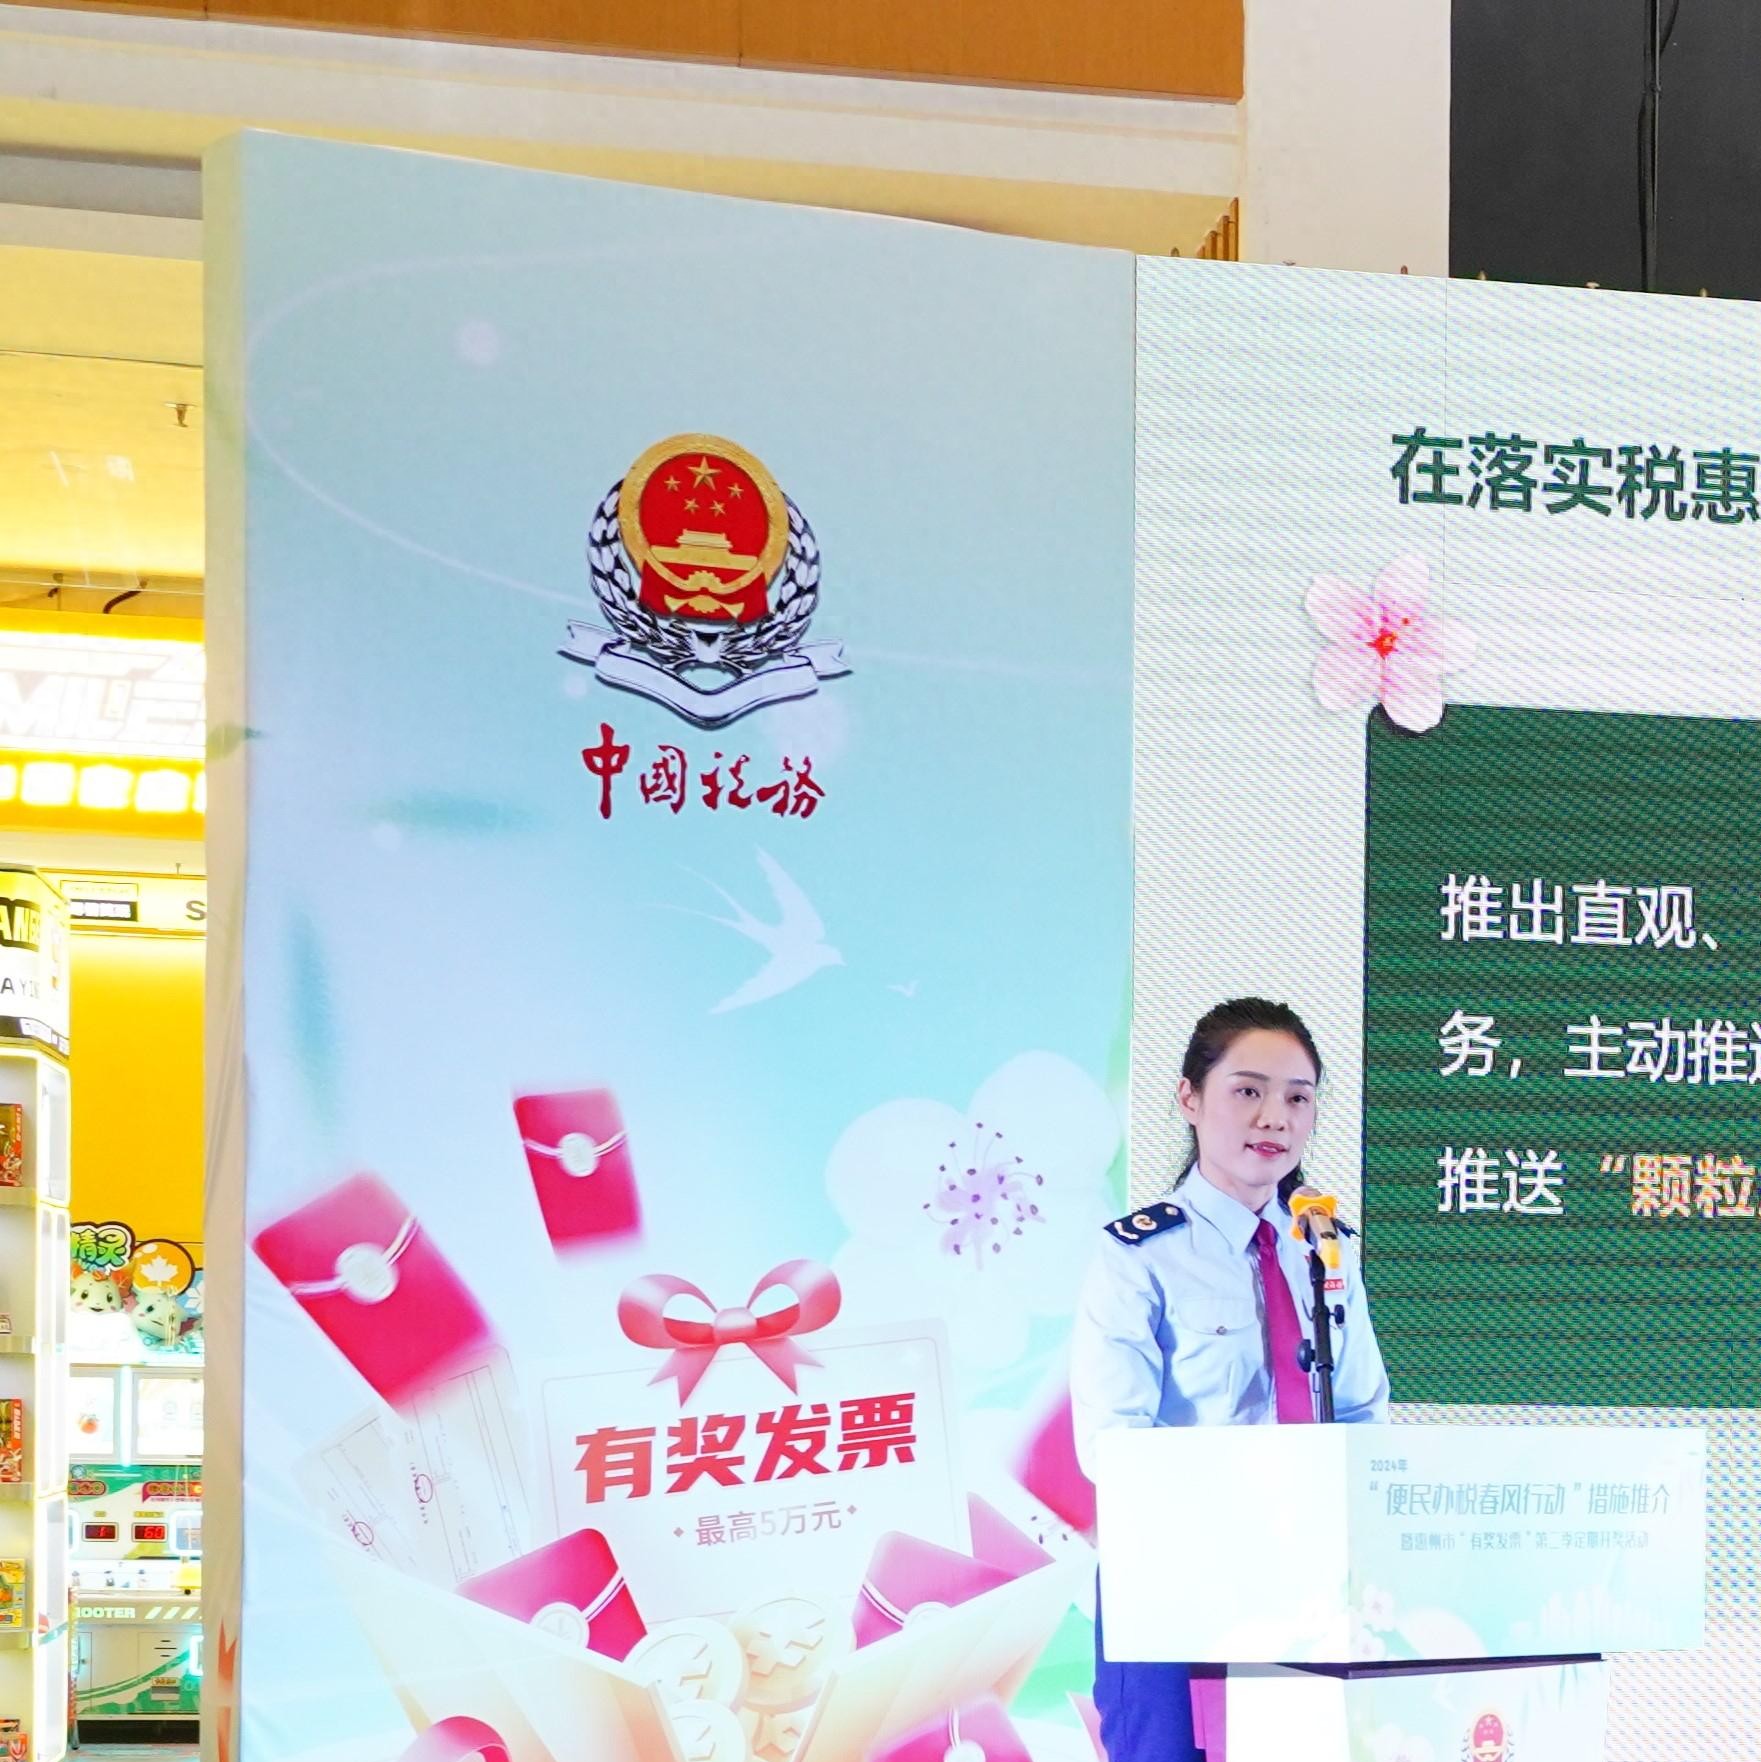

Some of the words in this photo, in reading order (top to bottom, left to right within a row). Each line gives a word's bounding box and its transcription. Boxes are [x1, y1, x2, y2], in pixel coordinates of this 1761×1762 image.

[575, 1392, 916, 1504] 有奖发票
[1370, 1459, 1408, 1472] 2024年
[695, 1500, 843, 1547] 最高5万元
